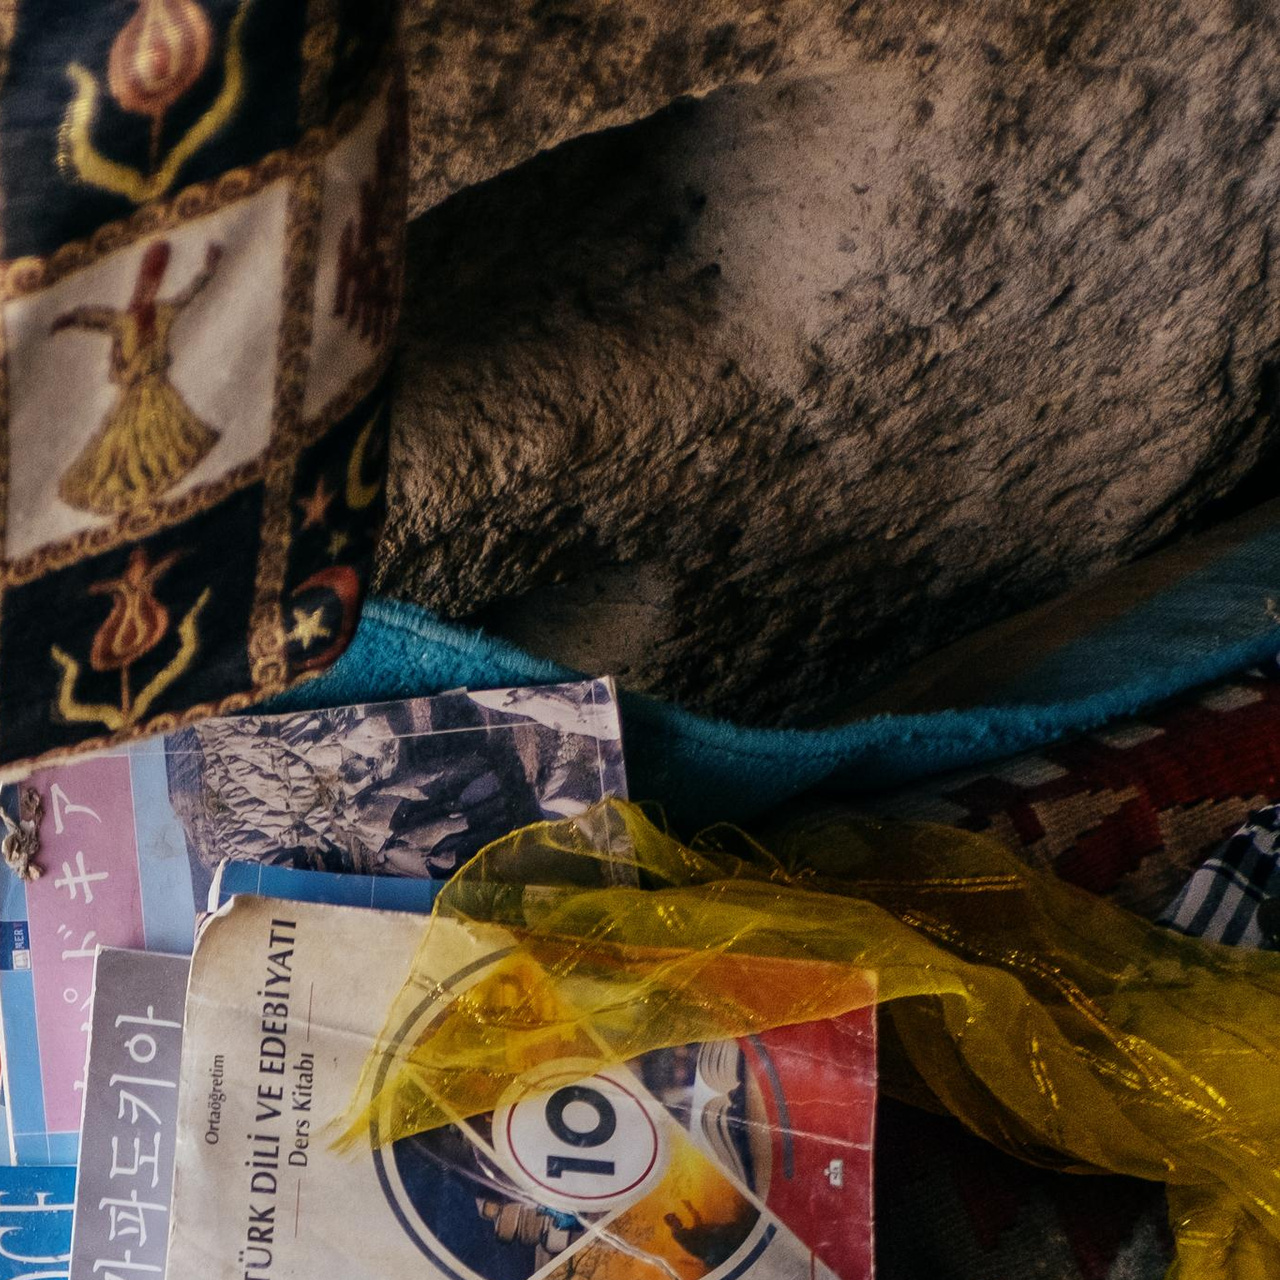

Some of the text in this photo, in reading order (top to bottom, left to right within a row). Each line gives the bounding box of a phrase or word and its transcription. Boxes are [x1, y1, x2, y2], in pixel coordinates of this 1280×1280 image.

[255, 918, 297, 1075] EDEBİYATI
[203, 1054, 226, 1145] Ortaöğretim
[256, 1085, 286, 1123] VE
[287, 1052, 316, 1168] Ders Kitabı
[544, 1084, 616, 1180] 10
[244, 1133, 281, 1196] DİLİ
